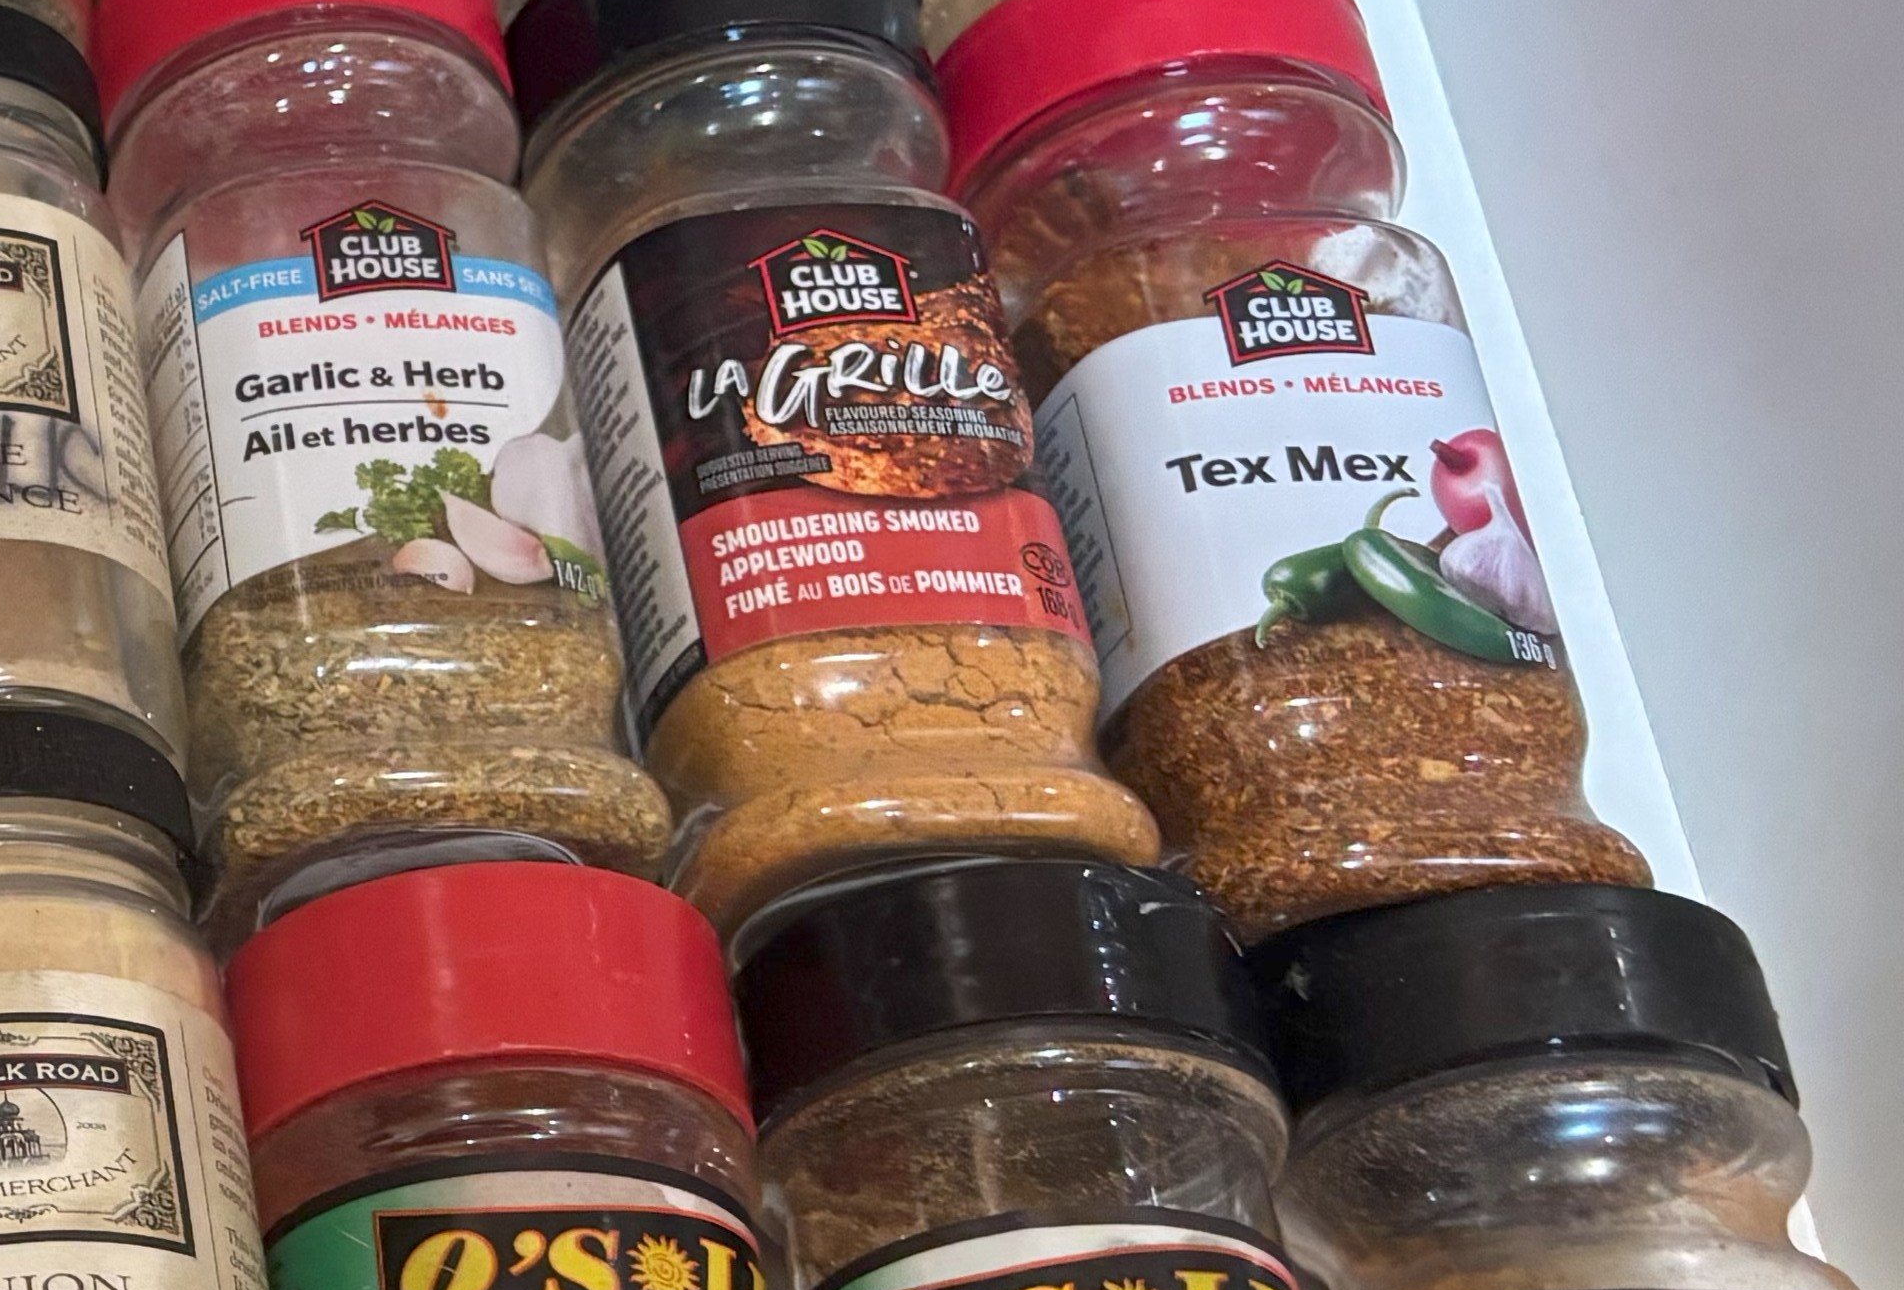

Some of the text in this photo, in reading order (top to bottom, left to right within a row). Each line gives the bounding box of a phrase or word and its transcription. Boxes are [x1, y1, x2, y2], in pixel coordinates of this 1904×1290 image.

[339, 235, 423, 257] CLUB
[329, 254, 442, 286] HOUSE
[790, 263, 881, 288] CLUB
[196, 269, 304, 312] SALT-FREE
[781, 284, 903, 319] HOUSE
[258, 309, 517, 339] BLENDS MÉLANGES
[235, 360, 505, 404] Garlic & Herb
[1168, 374, 1444, 404] BLENDS MÉLANGES
[243, 414, 492, 463] Ail et herbes
[1165, 445, 1416, 494] Tex Mex
[711, 508, 980, 559] SMOULDERING SMOKED
[719, 540, 865, 587] APPLEWOOD
[725, 570, 1024, 620] FUMÉ AU BOIS DE POMMIER
[36, 1062, 120, 1085] ROAD
